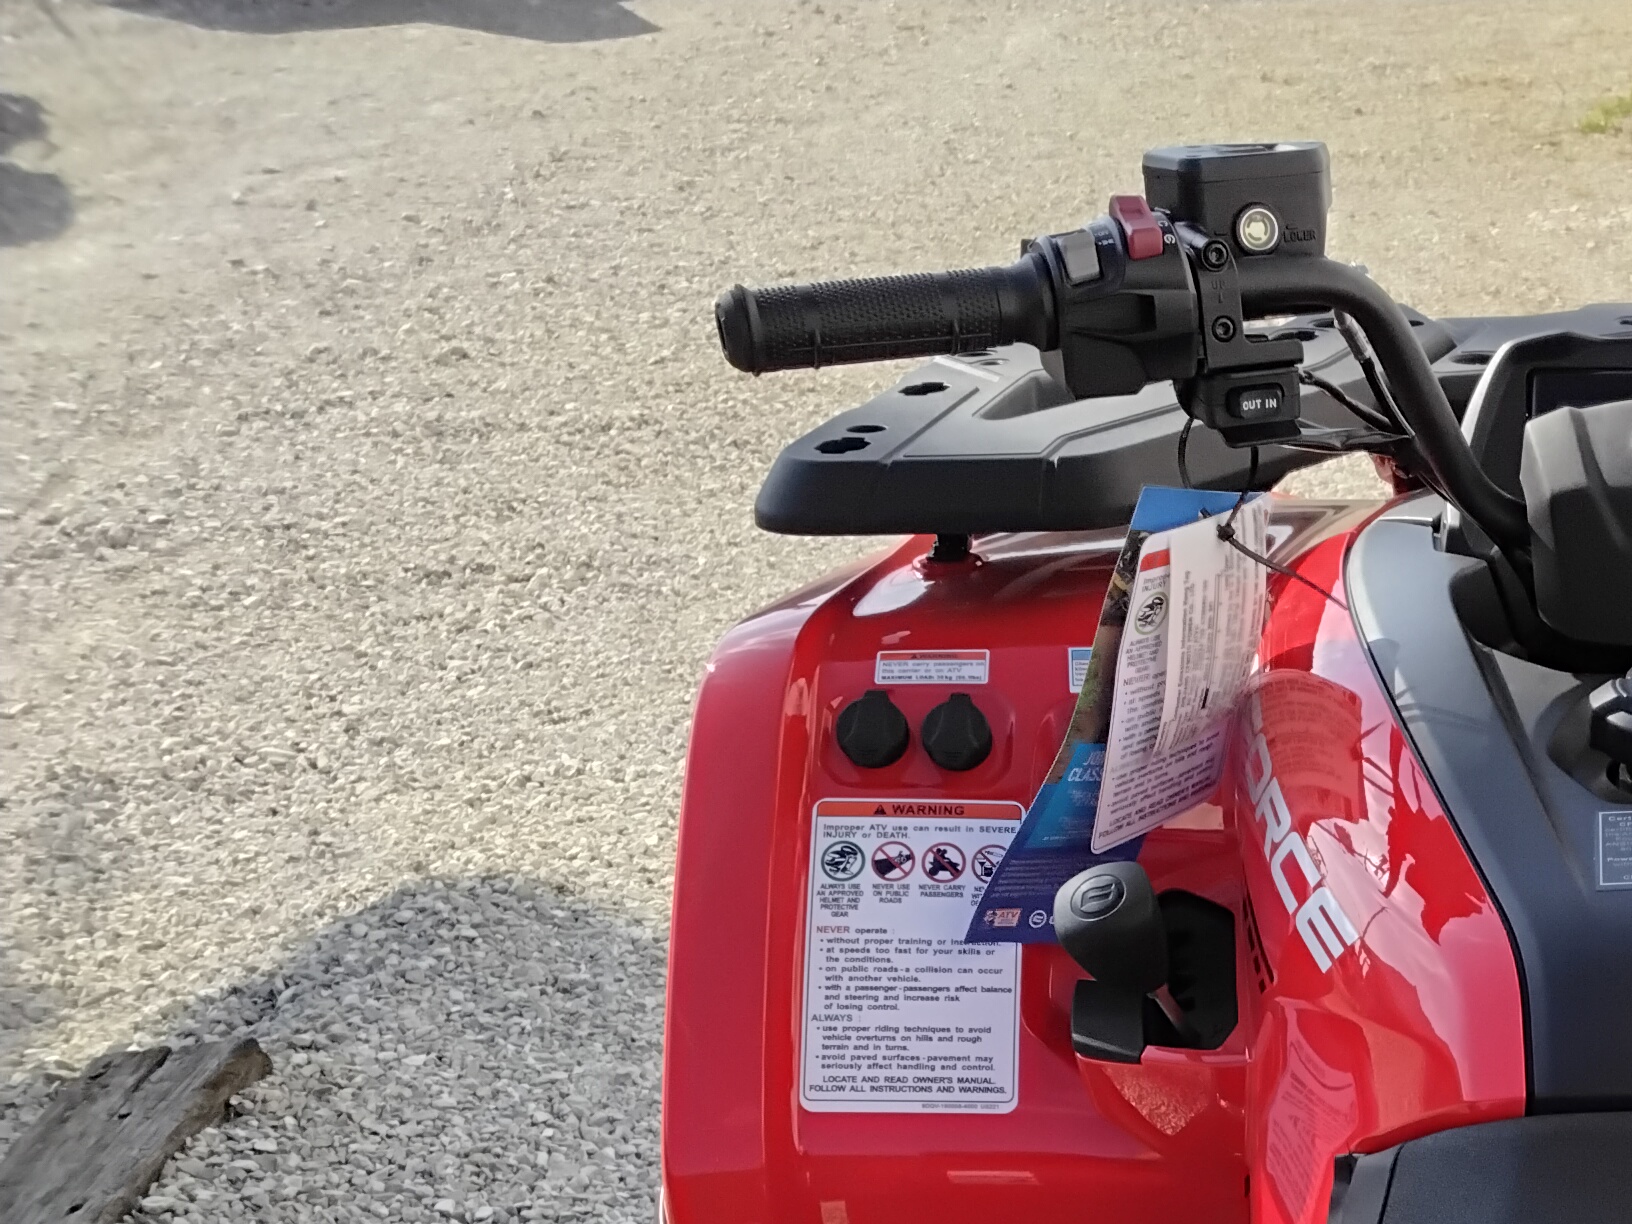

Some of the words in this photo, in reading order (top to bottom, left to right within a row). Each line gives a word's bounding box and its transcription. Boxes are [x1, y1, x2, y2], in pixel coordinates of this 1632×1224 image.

[1243, 399, 1261, 410] OUT
[1266, 398, 1276, 408] IN
[892, 804, 965, 815] WARNING
[824, 824, 865, 832] Improper
[898, 938, 932, 946] training
[839, 947, 870, 955] speeds
[845, 994, 879, 1002] steering
[837, 1003, 863, 1011] losing
[811, 1014, 853, 1022] ALWAYS
[875, 1025, 899, 1034] riding
[904, 1026, 951, 1034] techniques
[821, 1063, 862, 1071] seriously
[897, 1063, 935, 1071] handling
[870, 1085, 933, 1093] INSTRUCTIONS
